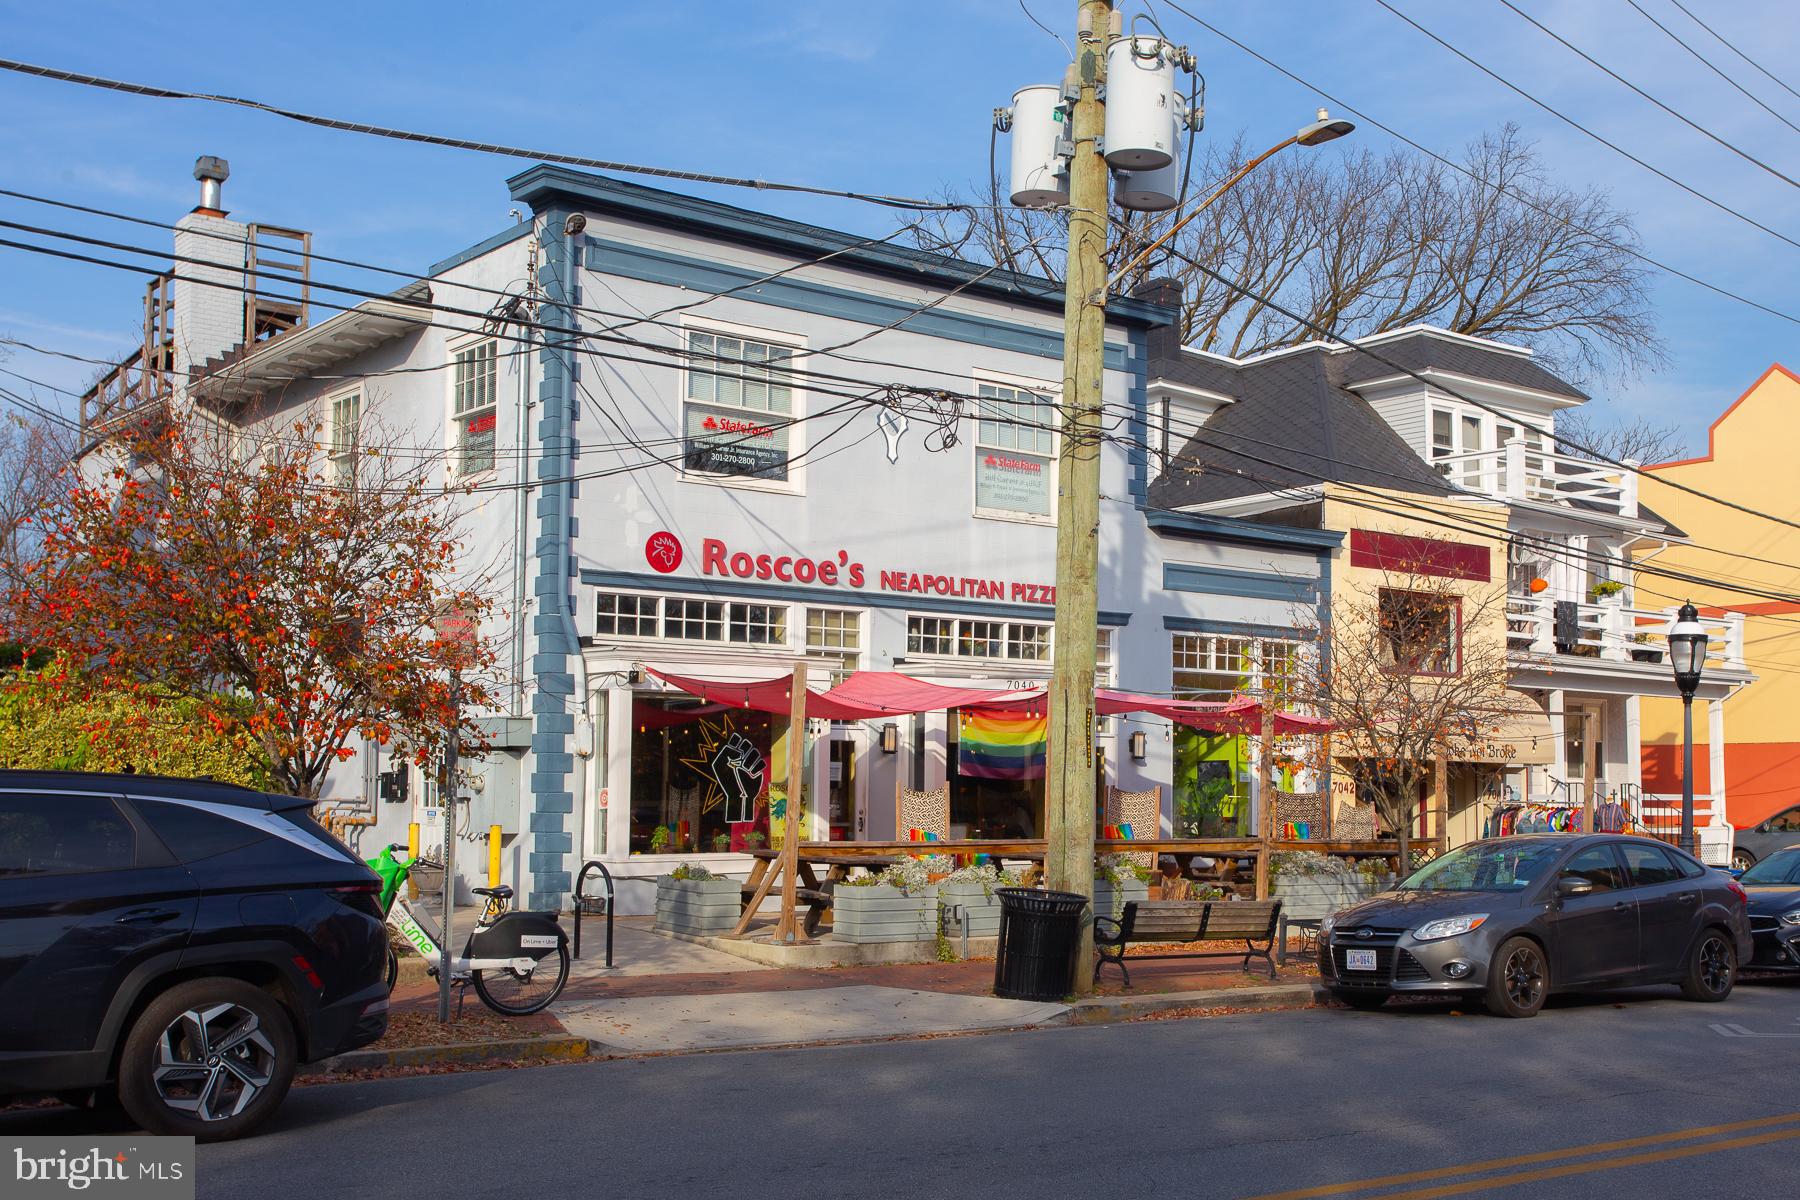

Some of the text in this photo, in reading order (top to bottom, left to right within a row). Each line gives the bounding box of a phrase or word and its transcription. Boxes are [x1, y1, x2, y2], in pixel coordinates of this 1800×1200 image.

[711, 453, 755, 465] 301-270-2800
[702, 538, 865, 588] Roscoe's
[880, 570, 1005, 601] NEAPOLITAN
[1006, 680, 1035, 690] 7040
[1332, 781, 1355, 794] 7042
[401, 918, 433, 954] Lime
